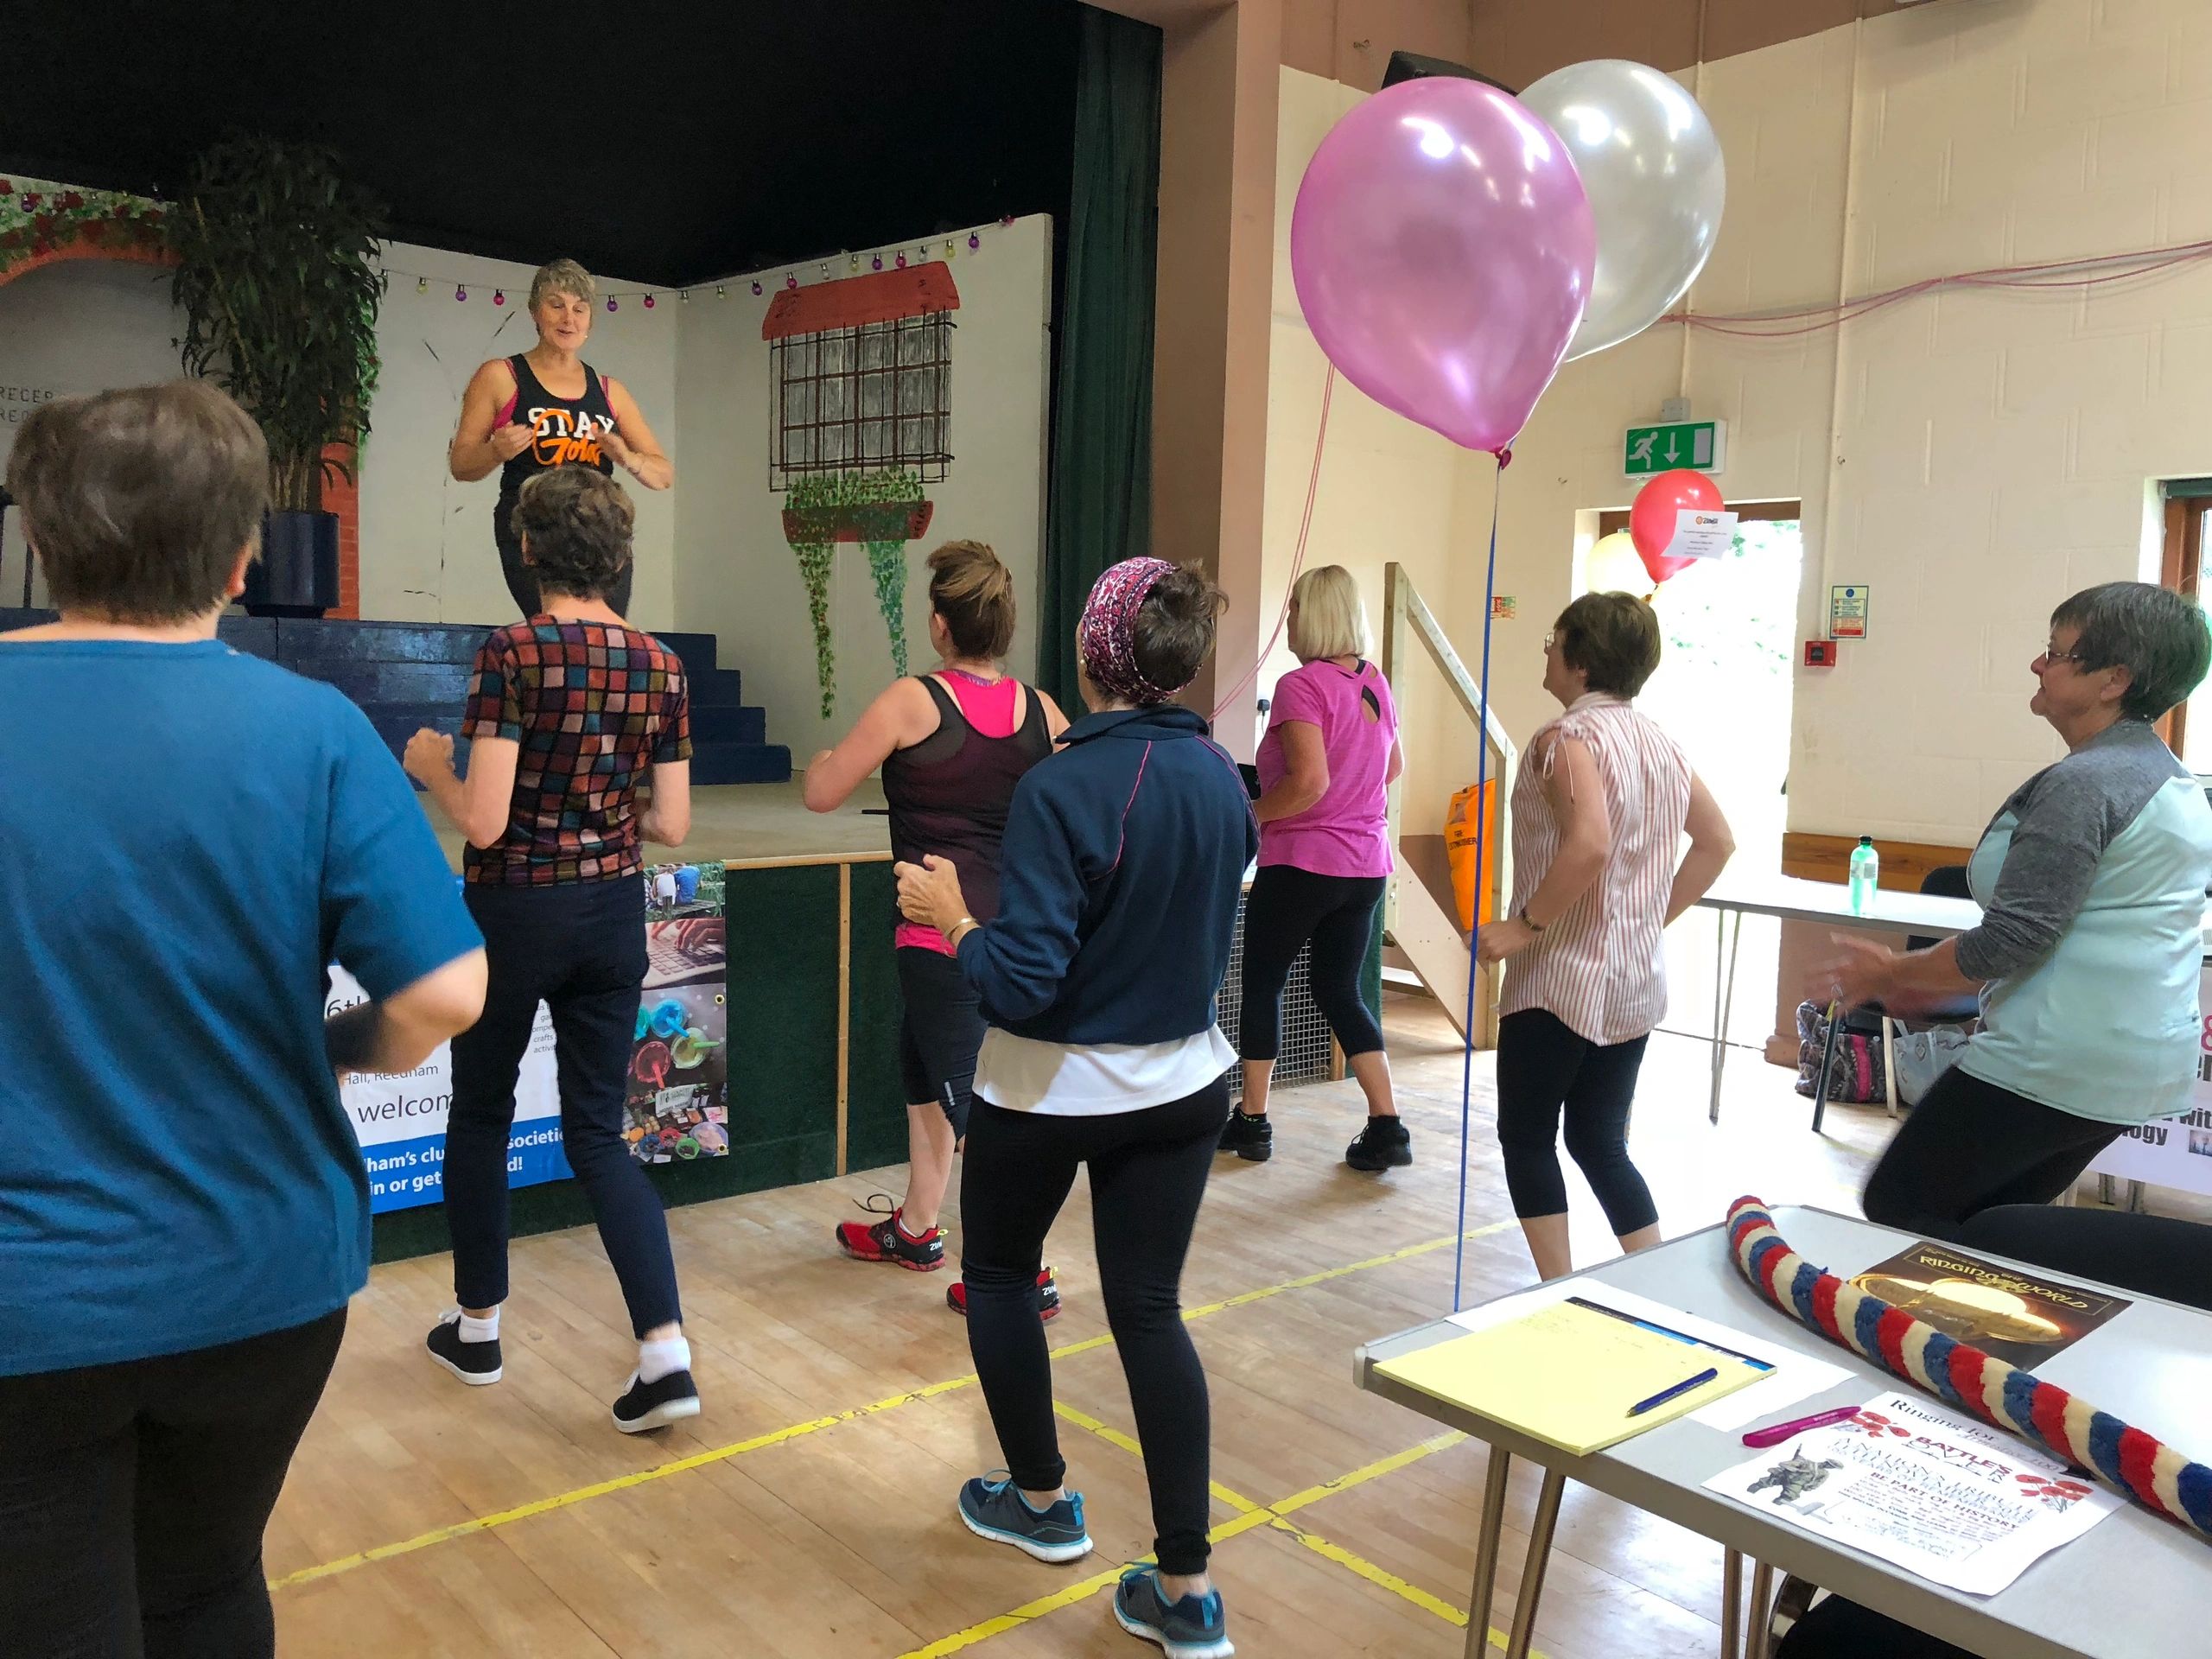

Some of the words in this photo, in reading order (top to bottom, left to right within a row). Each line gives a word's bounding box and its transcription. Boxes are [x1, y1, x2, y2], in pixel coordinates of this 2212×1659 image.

[528, 407, 614, 441] STAY
[365, 1151, 417, 1173] ham's
[389, 1179, 408, 1192] or
[412, 1173, 442, 1192] get
[2018, 1281, 2088, 1309] WORLD
[1890, 1399, 1962, 1431] Ringing
[1967, 1427, 1994, 1441] for
[1868, 1471, 1891, 1482] BE
[1888, 1479, 1929, 1497] PART
[1928, 1494, 1950, 1504] OF
[1952, 1503, 2018, 1530] HISTORY
